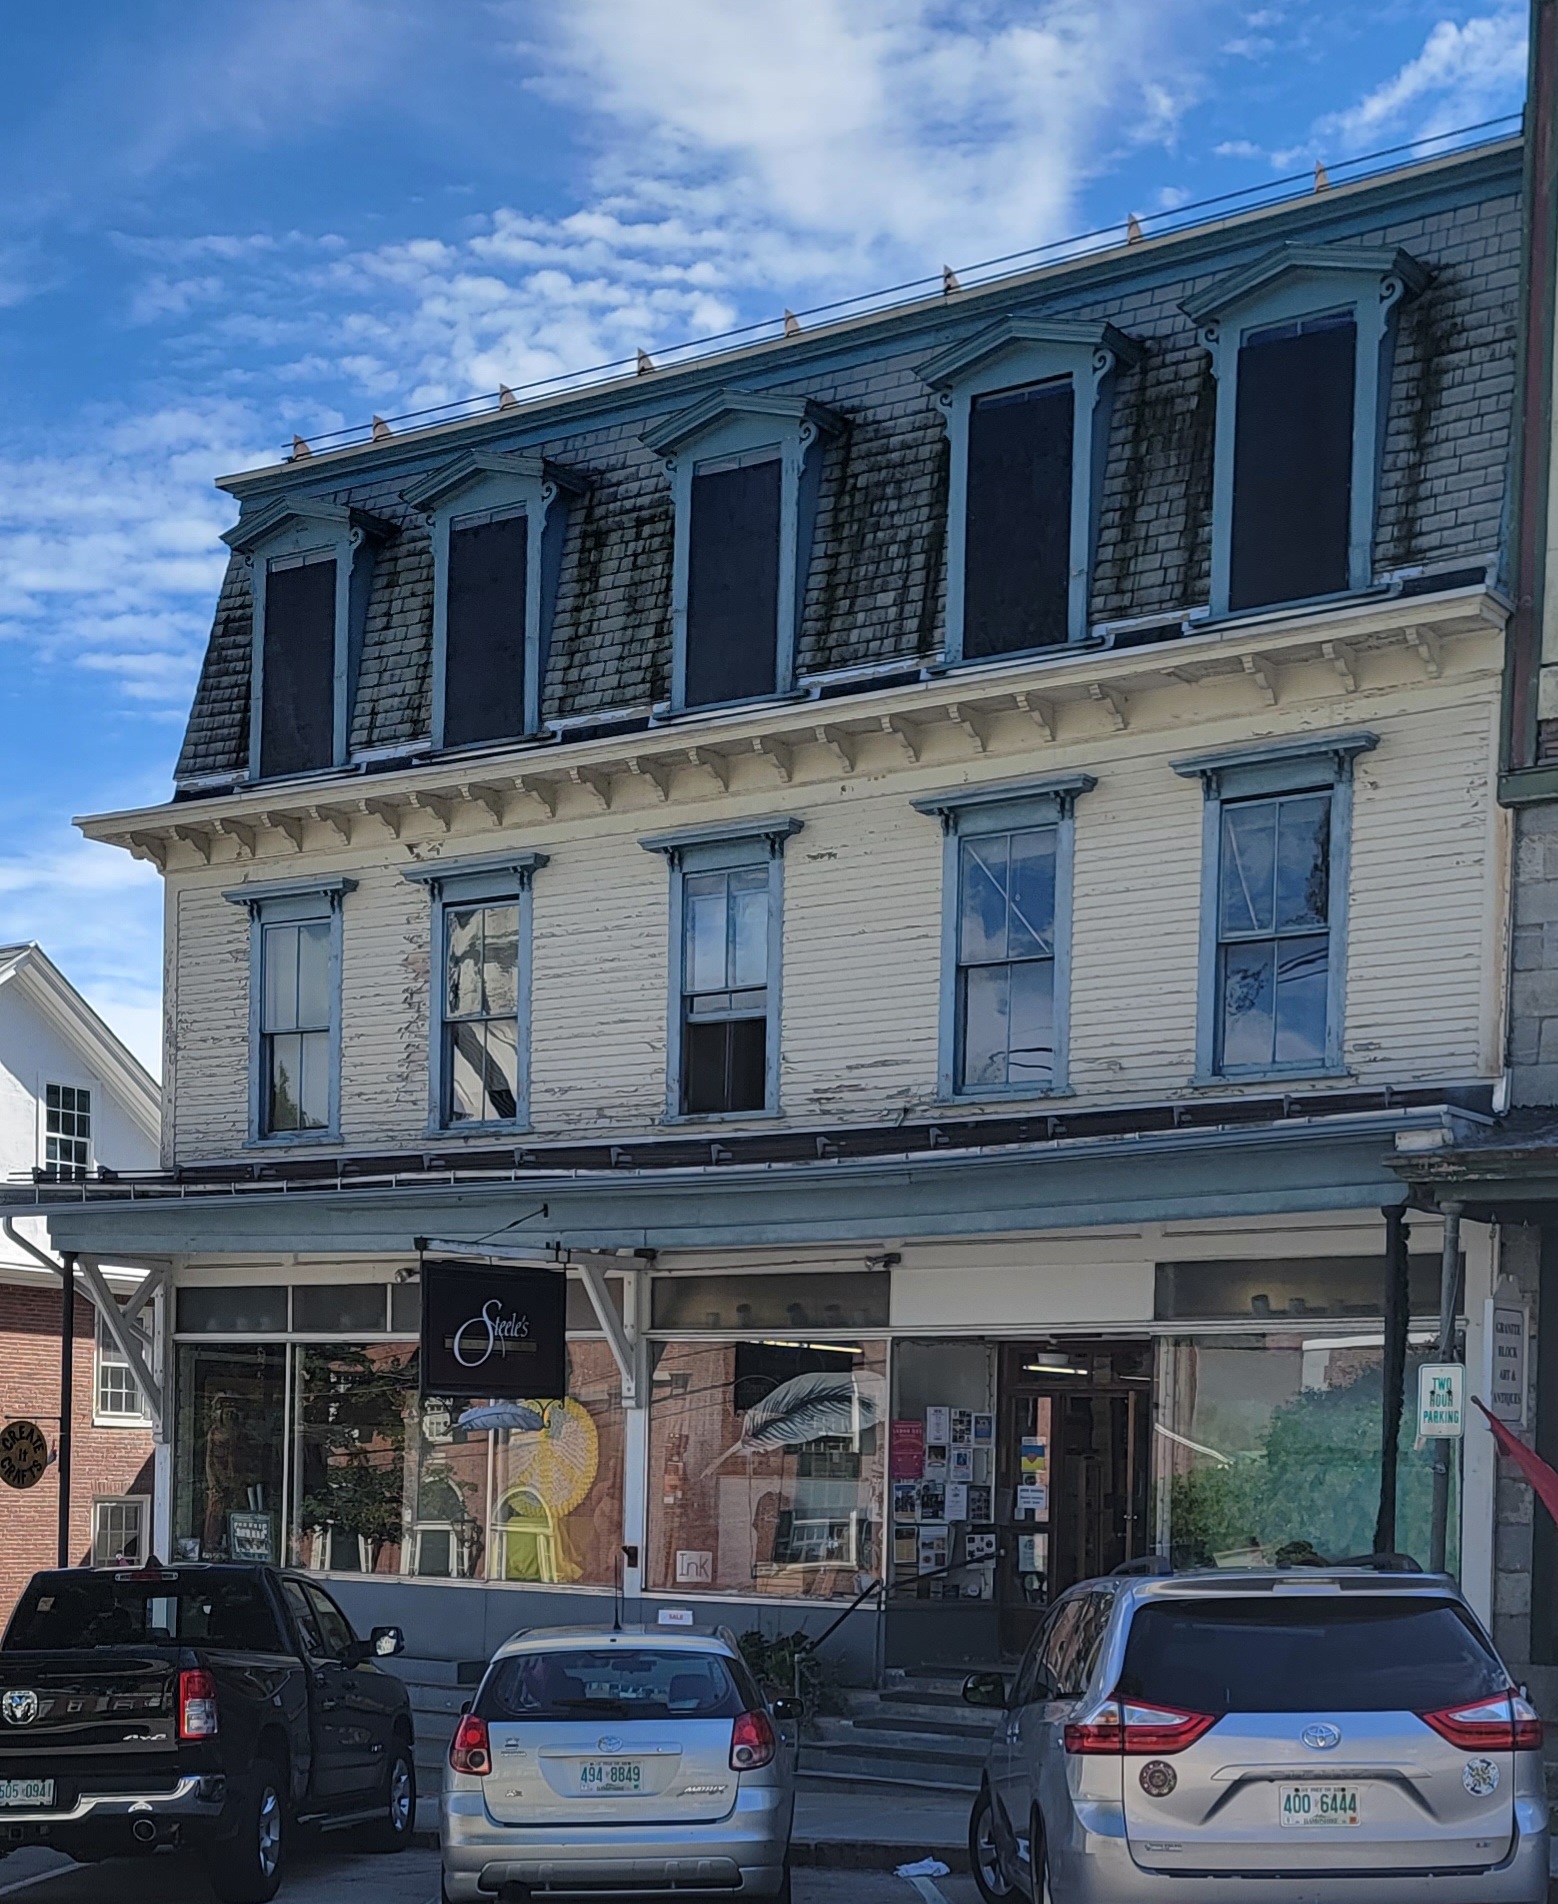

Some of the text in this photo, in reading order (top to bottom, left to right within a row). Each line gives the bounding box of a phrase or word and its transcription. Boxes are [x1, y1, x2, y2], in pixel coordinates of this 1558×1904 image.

[453, 1299, 530, 1367] Steele's
[1496, 1322, 1521, 1336] GRANITE
[1498, 1345, 1518, 1359] BLOCK
[1500, 1369, 1510, 1381] ART
[1432, 1377, 1452, 1391] TWO
[1429, 1391, 1454, 1407] HOUR
[1494, 1391, 1522, 1407] ANTIQUES
[1423, 1410, 1460, 1424] PARKING
[2, 1425, 45, 1454] CREATE
[0, 1456, 42, 1485] CRAFTS
[679, 1553, 710, 1578] Ink
[668, 1613, 684, 1621] SALE
[580, 1765, 641, 1783] 494 8849
[0, 1783, 19, 1798] 505
[1284, 1792, 1357, 1814] 400 6444
